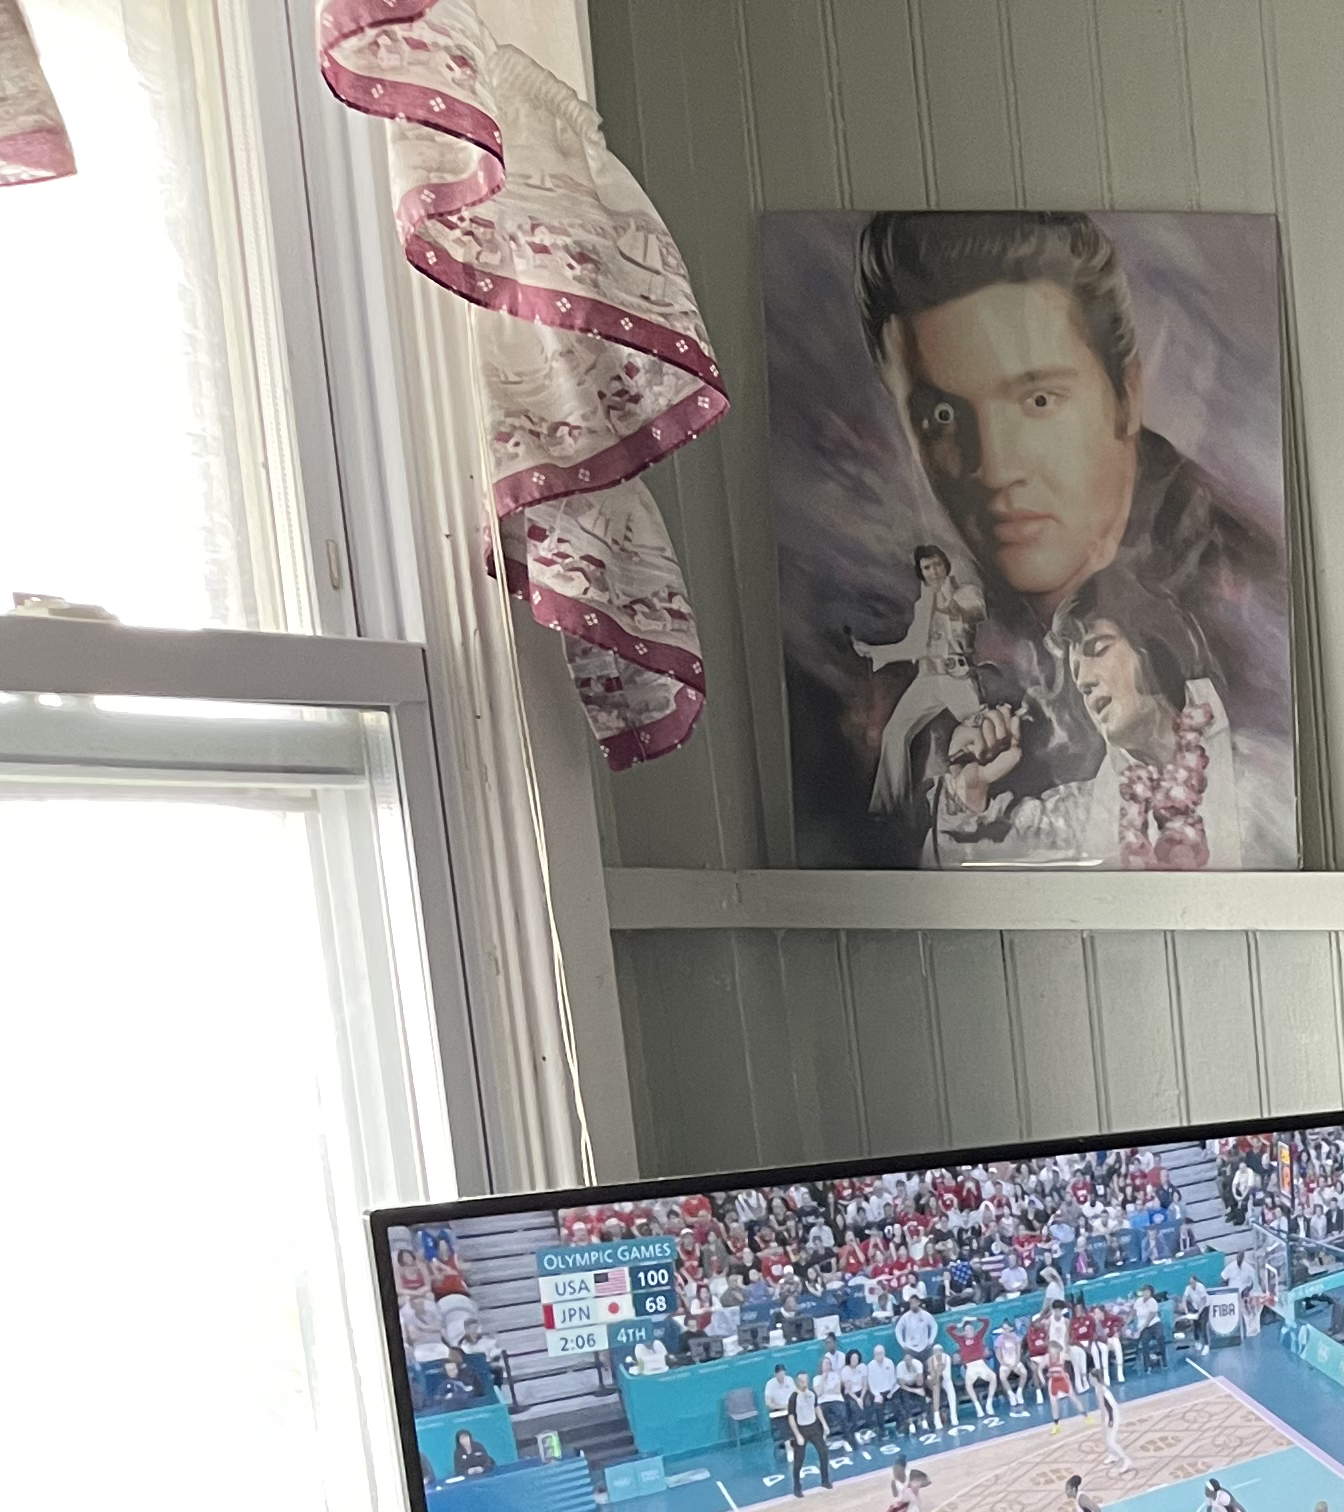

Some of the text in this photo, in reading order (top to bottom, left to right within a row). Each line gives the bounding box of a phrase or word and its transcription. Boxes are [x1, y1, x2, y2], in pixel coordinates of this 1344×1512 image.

[543, 1242, 672, 1271] OLYMPIC GAMES
[554, 1268, 669, 1297] USA 100
[560, 1295, 667, 1324] JPN 68
[1212, 1303, 1236, 1318] FIBA
[559, 1326, 647, 1352] 2:06 4TH
